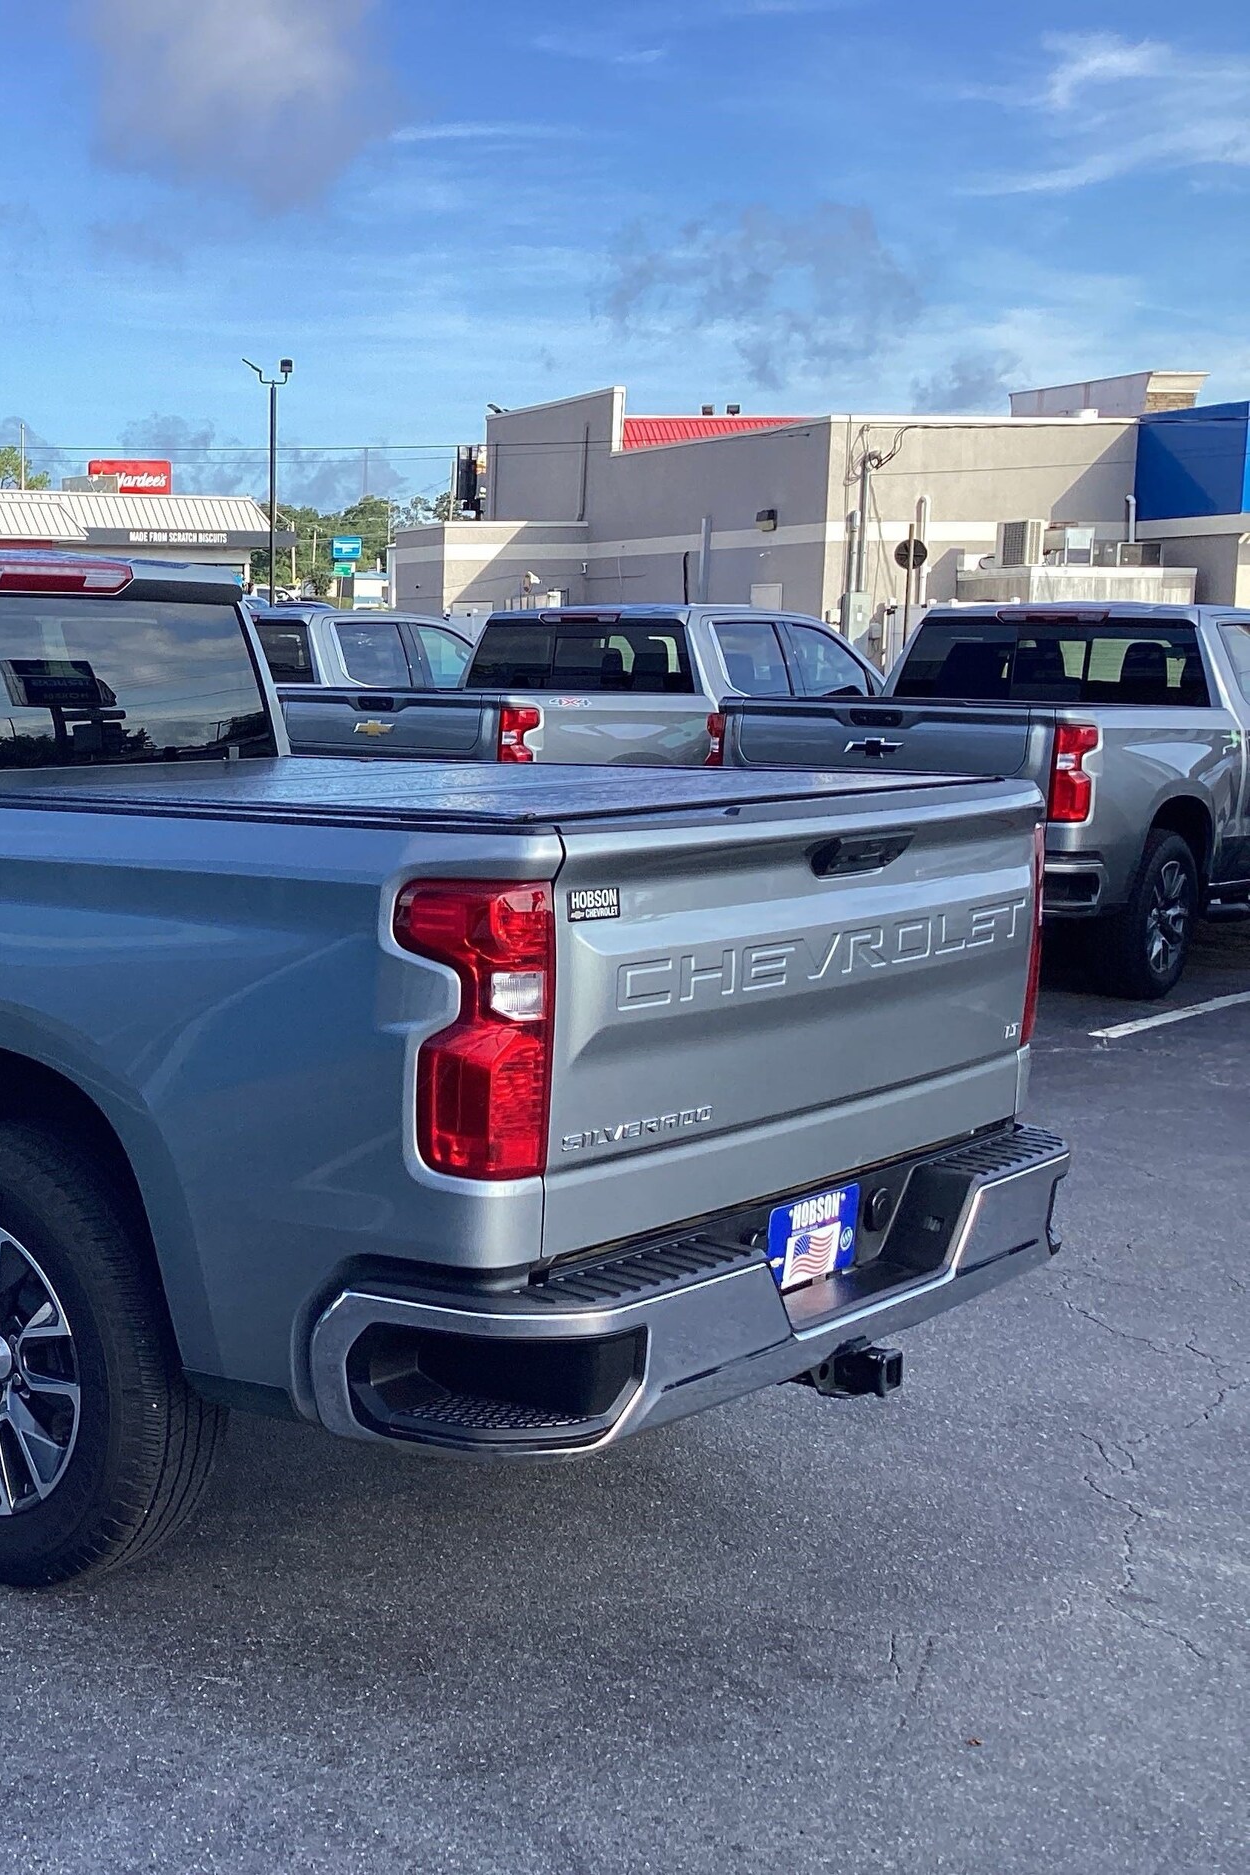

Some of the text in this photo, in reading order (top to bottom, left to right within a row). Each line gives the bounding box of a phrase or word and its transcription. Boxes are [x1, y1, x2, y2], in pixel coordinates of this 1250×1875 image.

[129, 531, 228, 544] MADE FROM SCRATCH BISCUITS
[571, 888, 618, 909] HOBSON
[585, 906, 619, 919] CHEVROLET
[617, 897, 1026, 1011] CHEVROLET
[561, 1104, 713, 1152] SILVERADO
[791, 1191, 841, 1231] HOBSON
